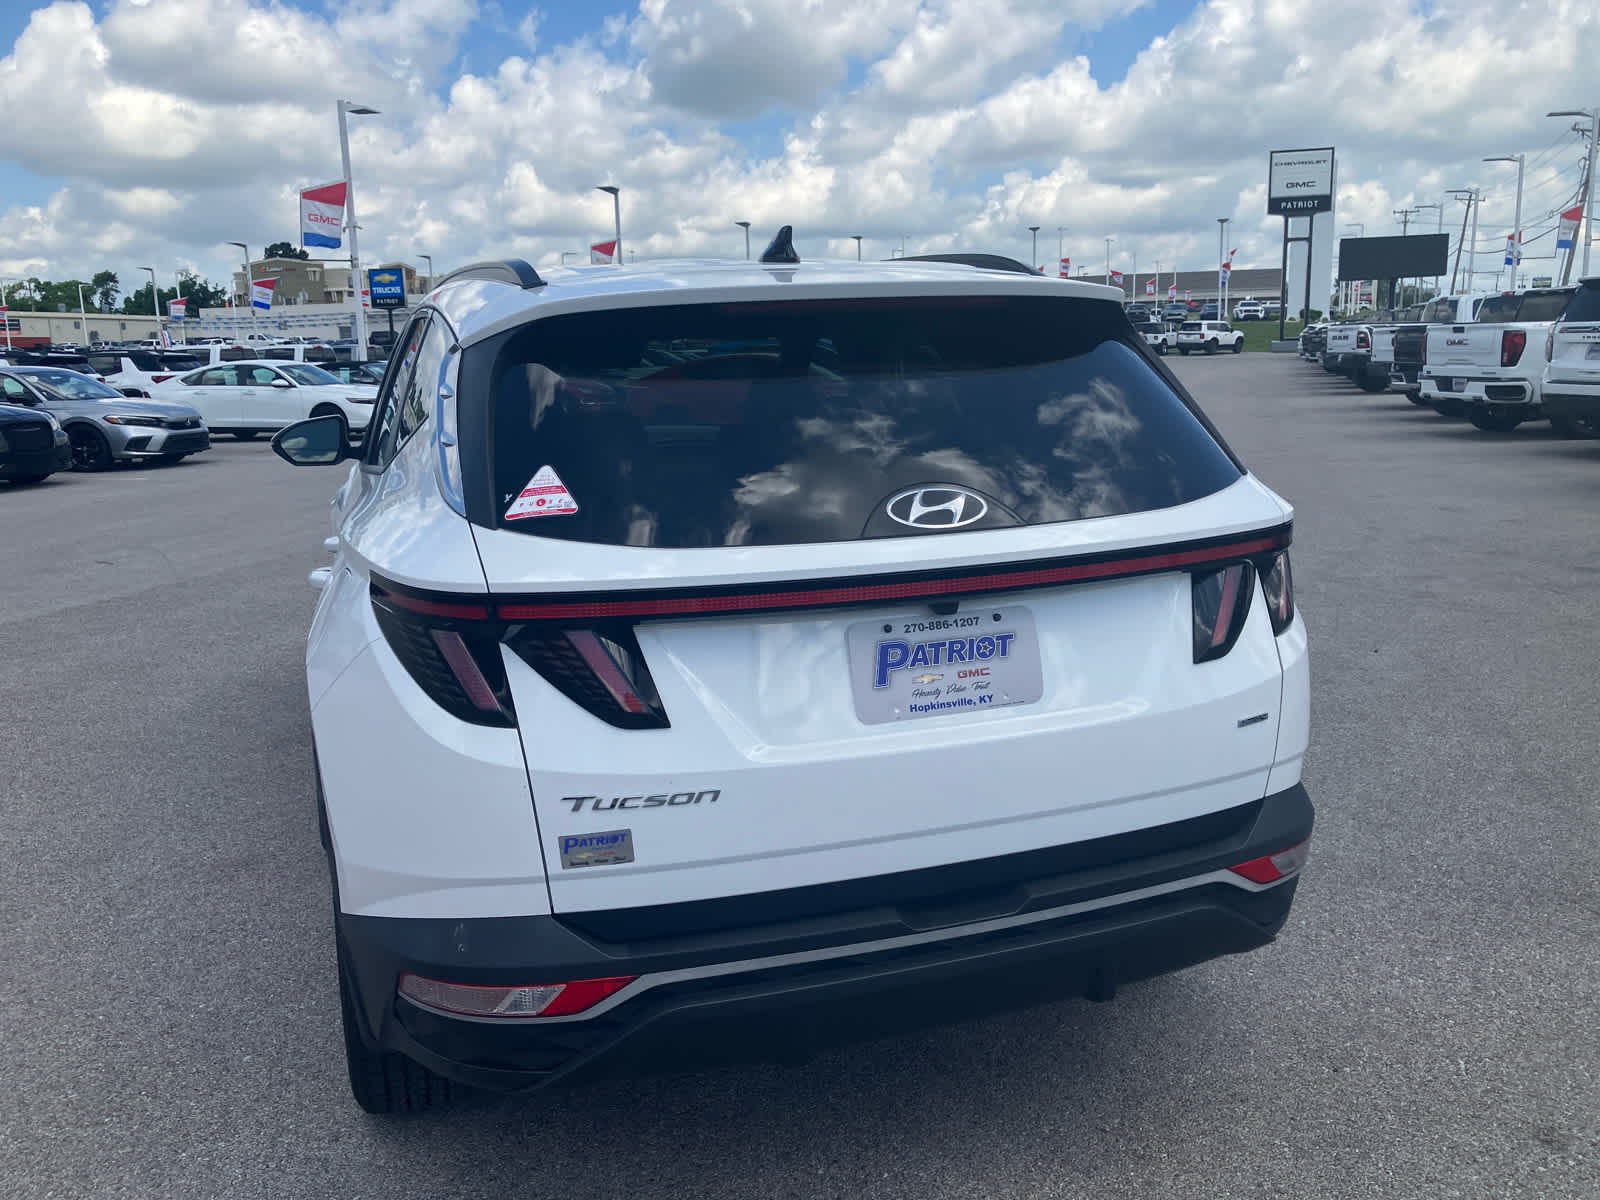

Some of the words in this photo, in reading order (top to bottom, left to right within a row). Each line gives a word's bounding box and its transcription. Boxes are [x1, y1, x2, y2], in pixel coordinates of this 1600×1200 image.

[1274, 159, 1328, 167] CHEVROLET
[1286, 181, 1317, 189] GMC
[1280, 200, 1319, 209] PATRIOT
[307, 212, 340, 227] GMC
[372, 286, 401, 294] TRUCKS
[1446, 338, 1469, 346] GMC
[903, 616, 980, 634] 270-886-1207
[874, 632, 1015, 689] PATRIOT
[957, 667, 991, 679] GMC
[909, 697, 977, 713] Hopkinsville,
[978, 694, 994, 704] KY
[563, 832, 628, 855] PATRIOT
